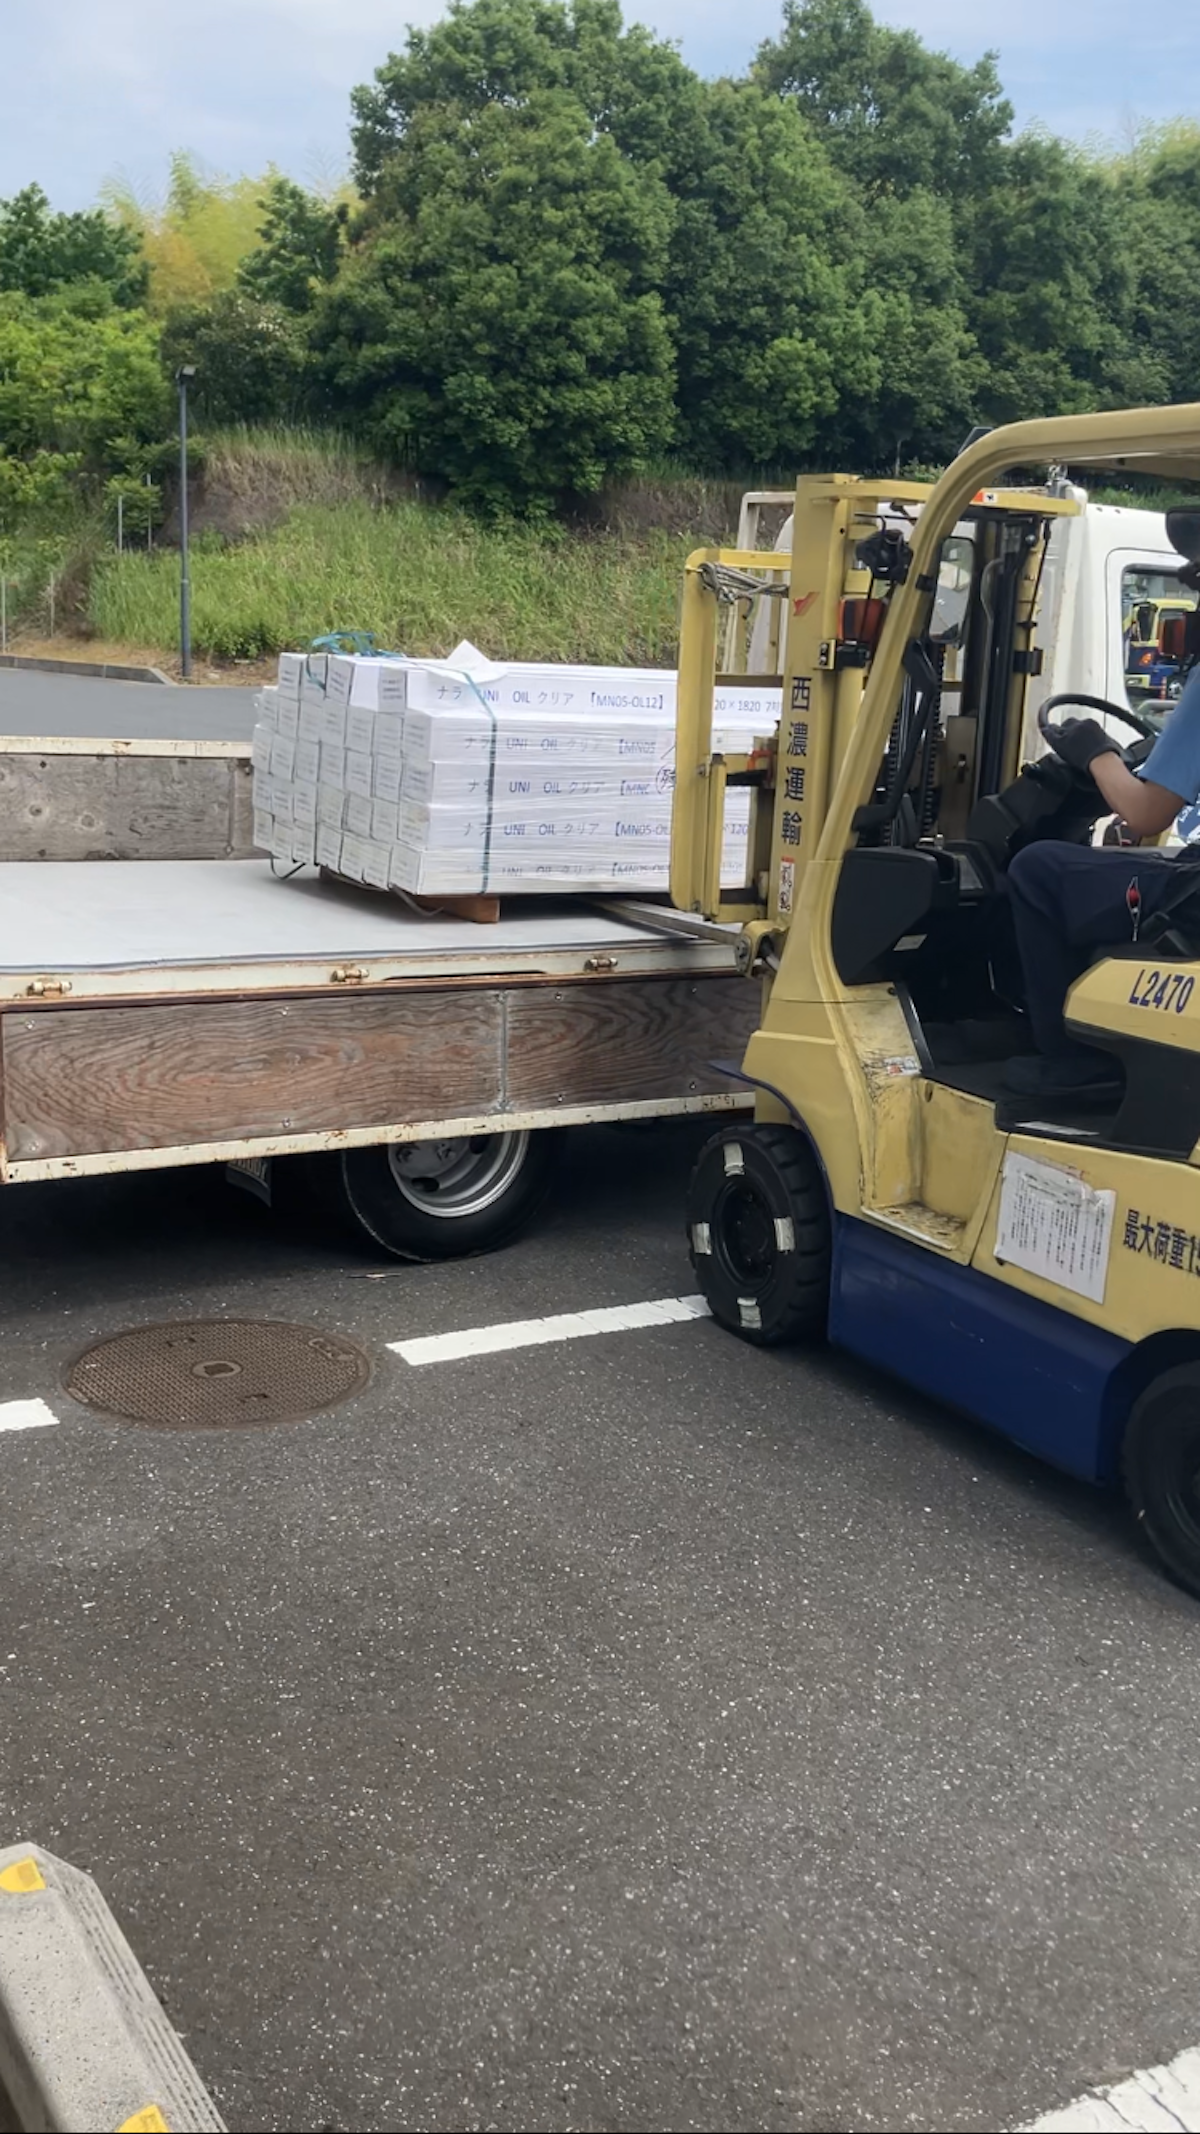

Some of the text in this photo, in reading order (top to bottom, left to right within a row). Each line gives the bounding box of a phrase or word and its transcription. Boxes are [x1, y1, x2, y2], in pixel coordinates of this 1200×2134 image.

[437, 685, 462, 700] ナラ
[512, 690, 531, 703] OIL
[537, 691, 574, 706] クリア
[781, 676, 812, 847] 西濃運輸
[508, 781, 531, 793] UNI
[543, 781, 562, 794] OIL
[503, 823, 526, 836] UNI
[1129, 968, 1196, 1014] L2470
